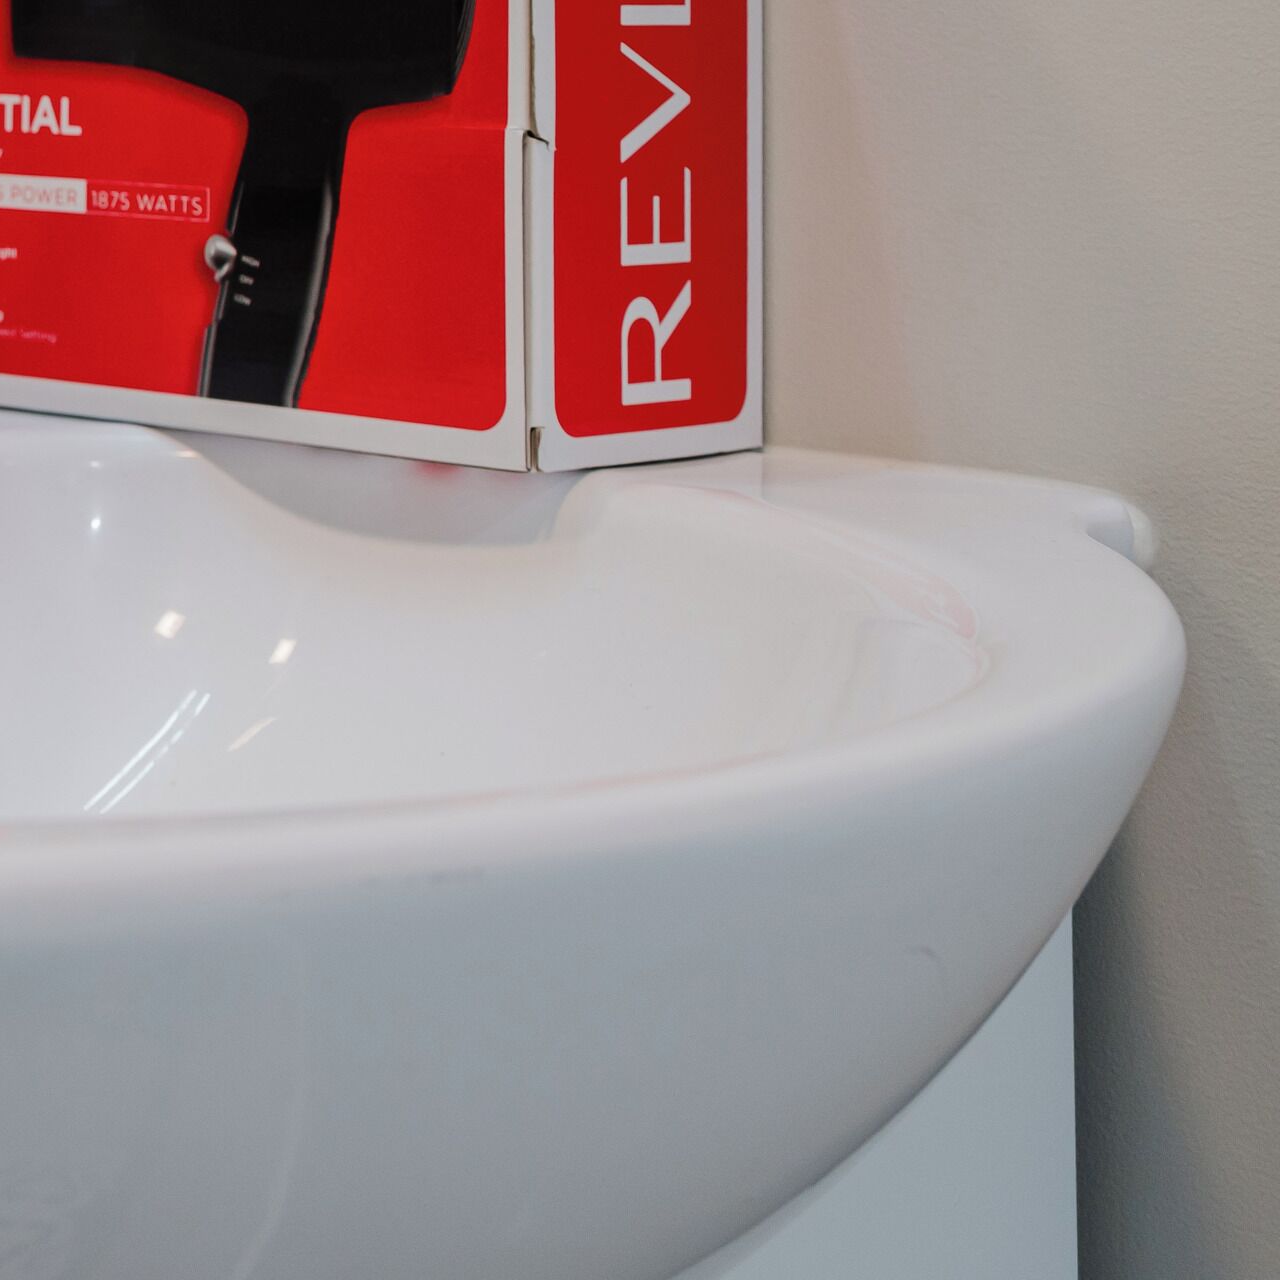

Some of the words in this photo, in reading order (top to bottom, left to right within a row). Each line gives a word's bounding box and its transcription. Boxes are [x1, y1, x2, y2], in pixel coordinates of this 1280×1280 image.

[10, 184, 78, 206] POWER
[91, 190, 131, 211] 1875
[136, 192, 203, 217] WATTS
